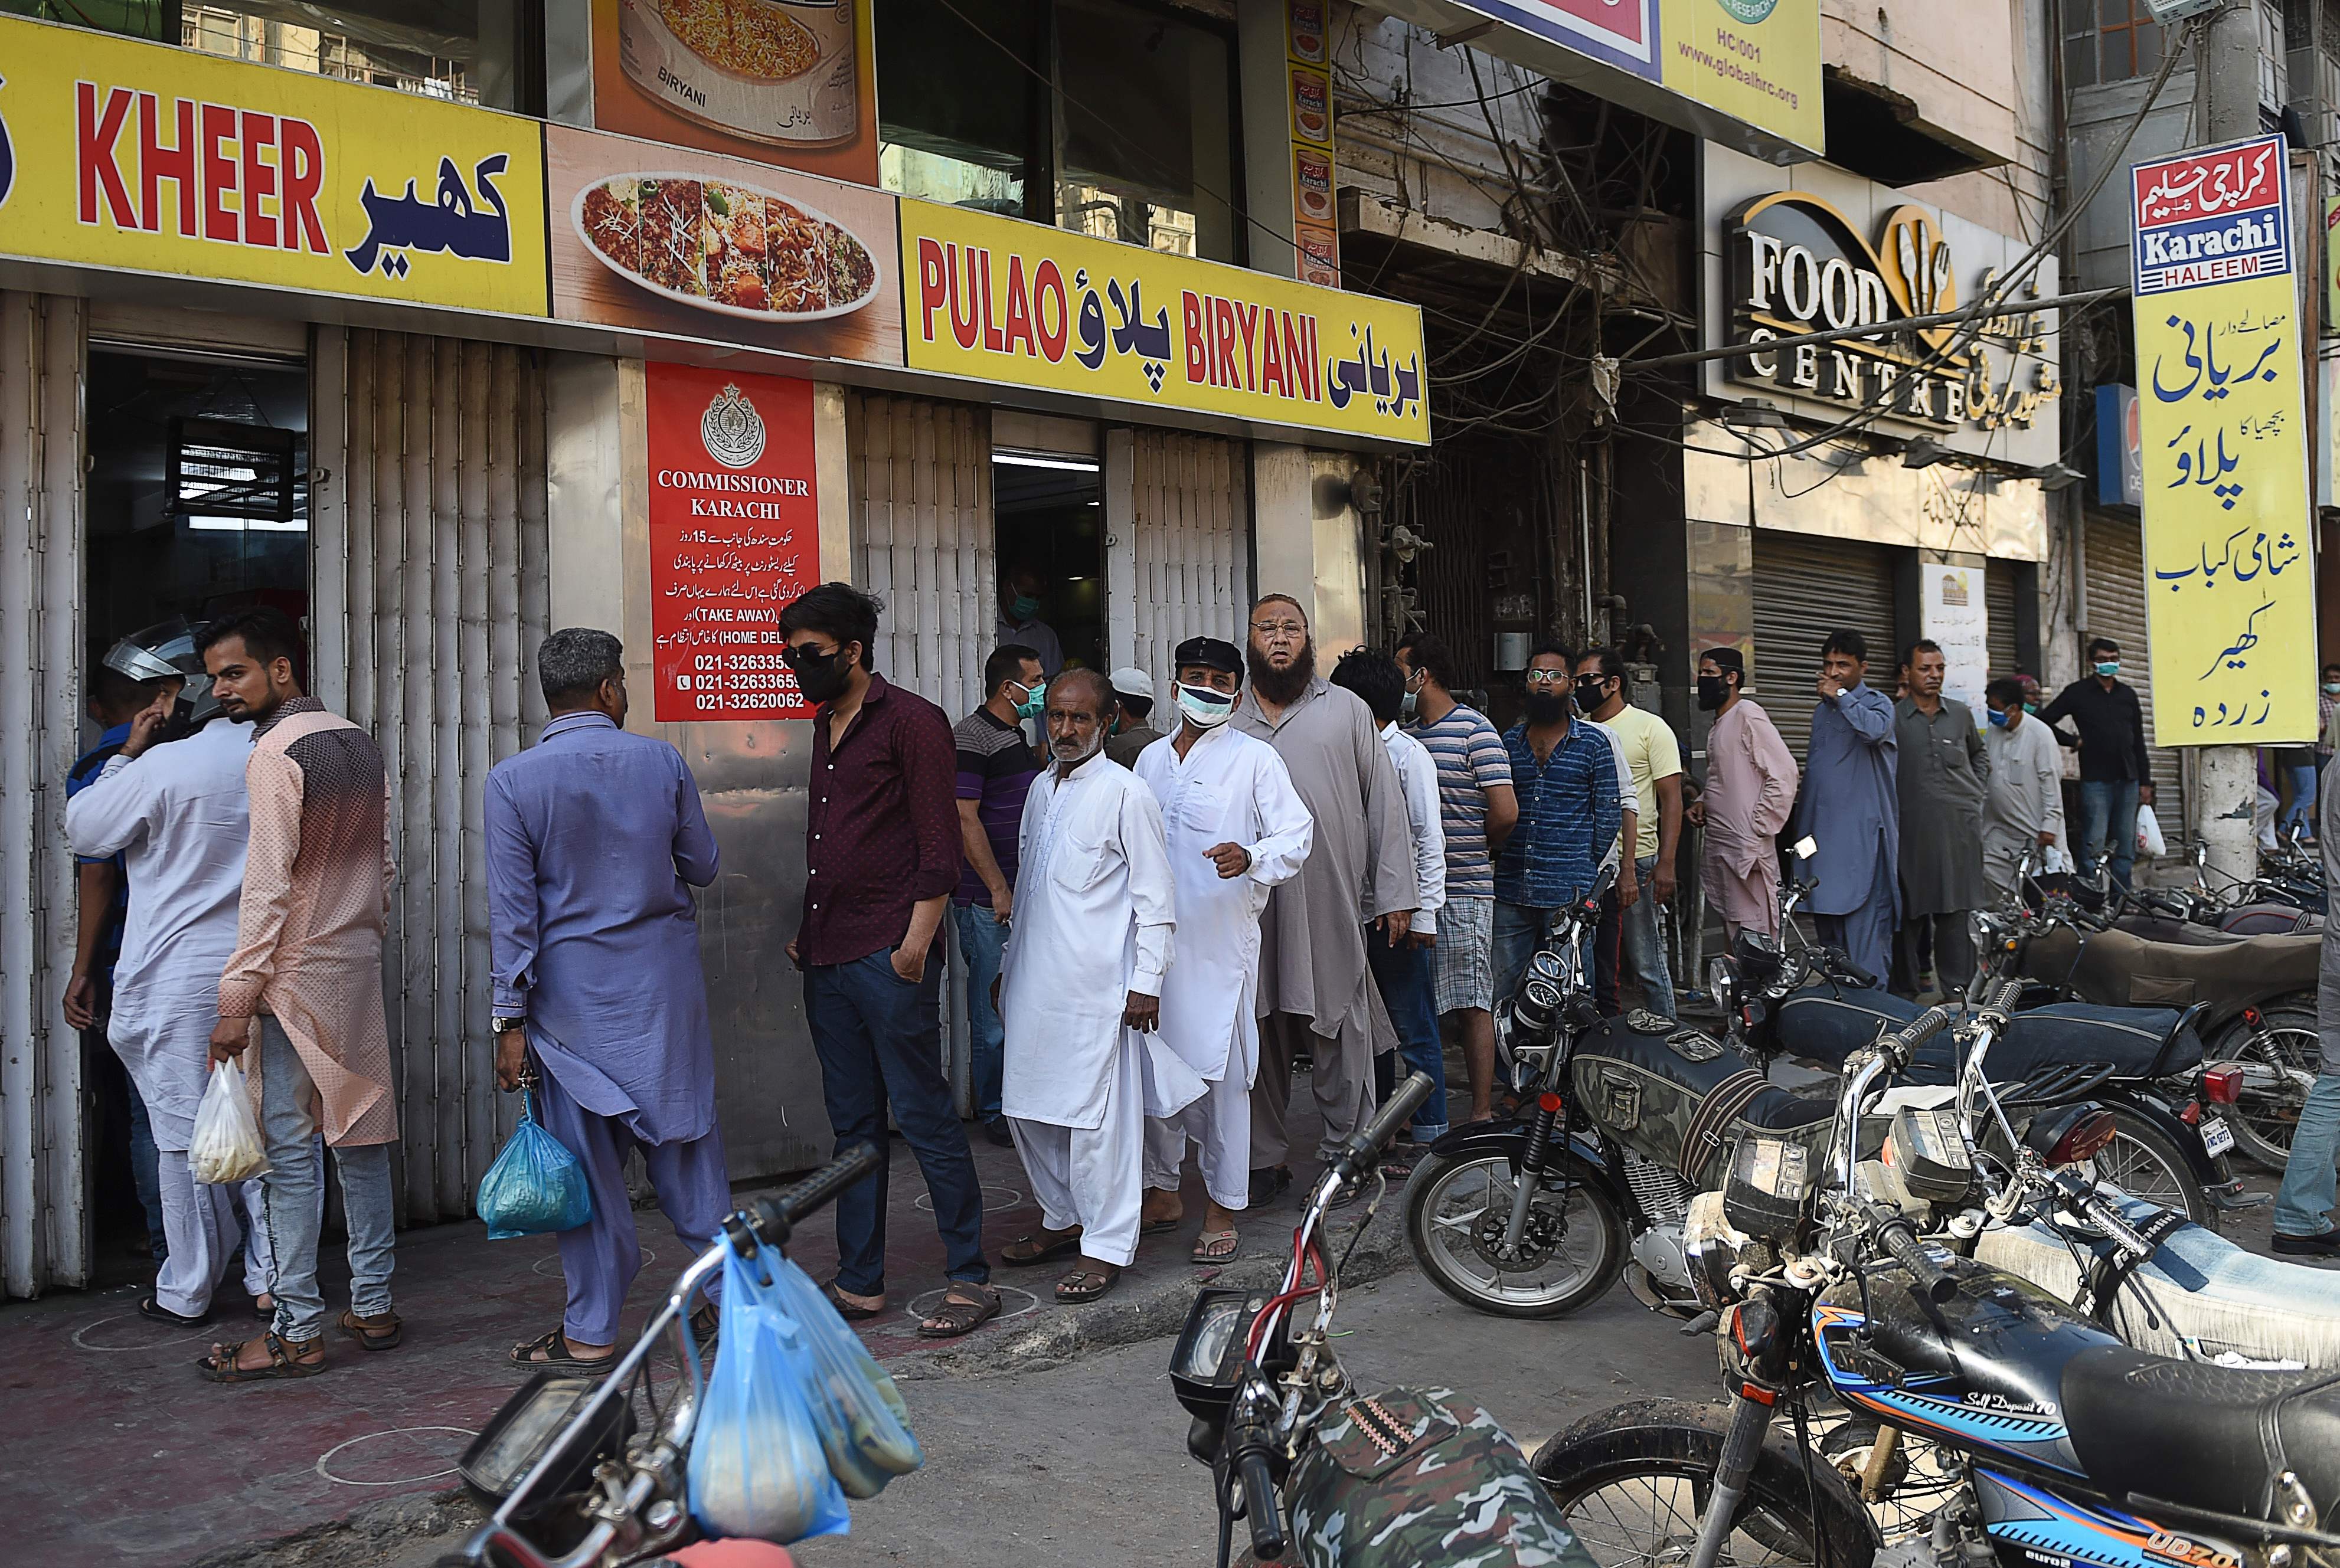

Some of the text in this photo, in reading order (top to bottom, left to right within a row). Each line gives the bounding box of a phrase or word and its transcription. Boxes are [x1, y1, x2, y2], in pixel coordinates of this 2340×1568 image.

[1677, 41, 1798, 110] www.globalhrc.org
[657, 66, 707, 108] BIRYANI
[775, 105, 811, 129] بریانی
[77, 81, 331, 256] KHEER
[1302, 174, 1326, 187] Karachi
[2142, 146, 2272, 224] کراچی حلیم
[345, 154, 510, 279] کھیر
[2143, 213, 2278, 266] Karachi
[2164, 256, 2259, 286] HALEEM
[1747, 230, 1888, 341] FOOD
[918, 237, 1067, 364] PULAO
[1073, 267, 1172, 395] پلاؤ
[1181, 288, 1322, 404] BIRYANI
[2153, 315, 2282, 403] بریانی
[1327, 322, 1422, 420] بریانی
[1749, 328, 1965, 424] CENTRE
[2240, 415, 2253, 436] کا
[2167, 424, 2243, 510] پلاؤ
[658, 470, 809, 496] COMMISSIONER
[691, 498, 781, 520] KARACHI
[679, 530, 692, 542] روز
[692, 530, 707, 544] 15
[708, 533, 722, 544] سے
[722, 532, 743, 548] جانب
[743, 526, 754, 547] کی
[751, 535, 769, 546] سندھ
[674, 554, 697, 574] پابندی
[697, 558, 704, 574] پر
[743, 561, 750, 577] پر
[2155, 526, 2300, 592] شامی کباب
[665, 582, 688, 598] صرف
[687, 582, 705, 600] یہاں
[705, 585, 731, 597] ہمارے
[758, 590, 770, 603] ہے
[770, 578, 782, 600] گئی
[795, 585, 809, 598] ائد
[683, 610, 695, 621] اور
[695, 606, 734, 625] (TAKE
[736, 607, 776, 624] AWAY)
[656, 633, 669, 649] ہے
[692, 630, 711, 646] خاص
[710, 628, 719, 643] کا
[719, 630, 757, 647] (HOME
[2198, 600, 2276, 681] کھیر
[696, 692, 804, 710] 021-32620062
[2192, 689, 2272, 728] زردہ
[2036, 1400, 2057, 1415] 70
[2025, 1550, 2071, 1568] euro2
